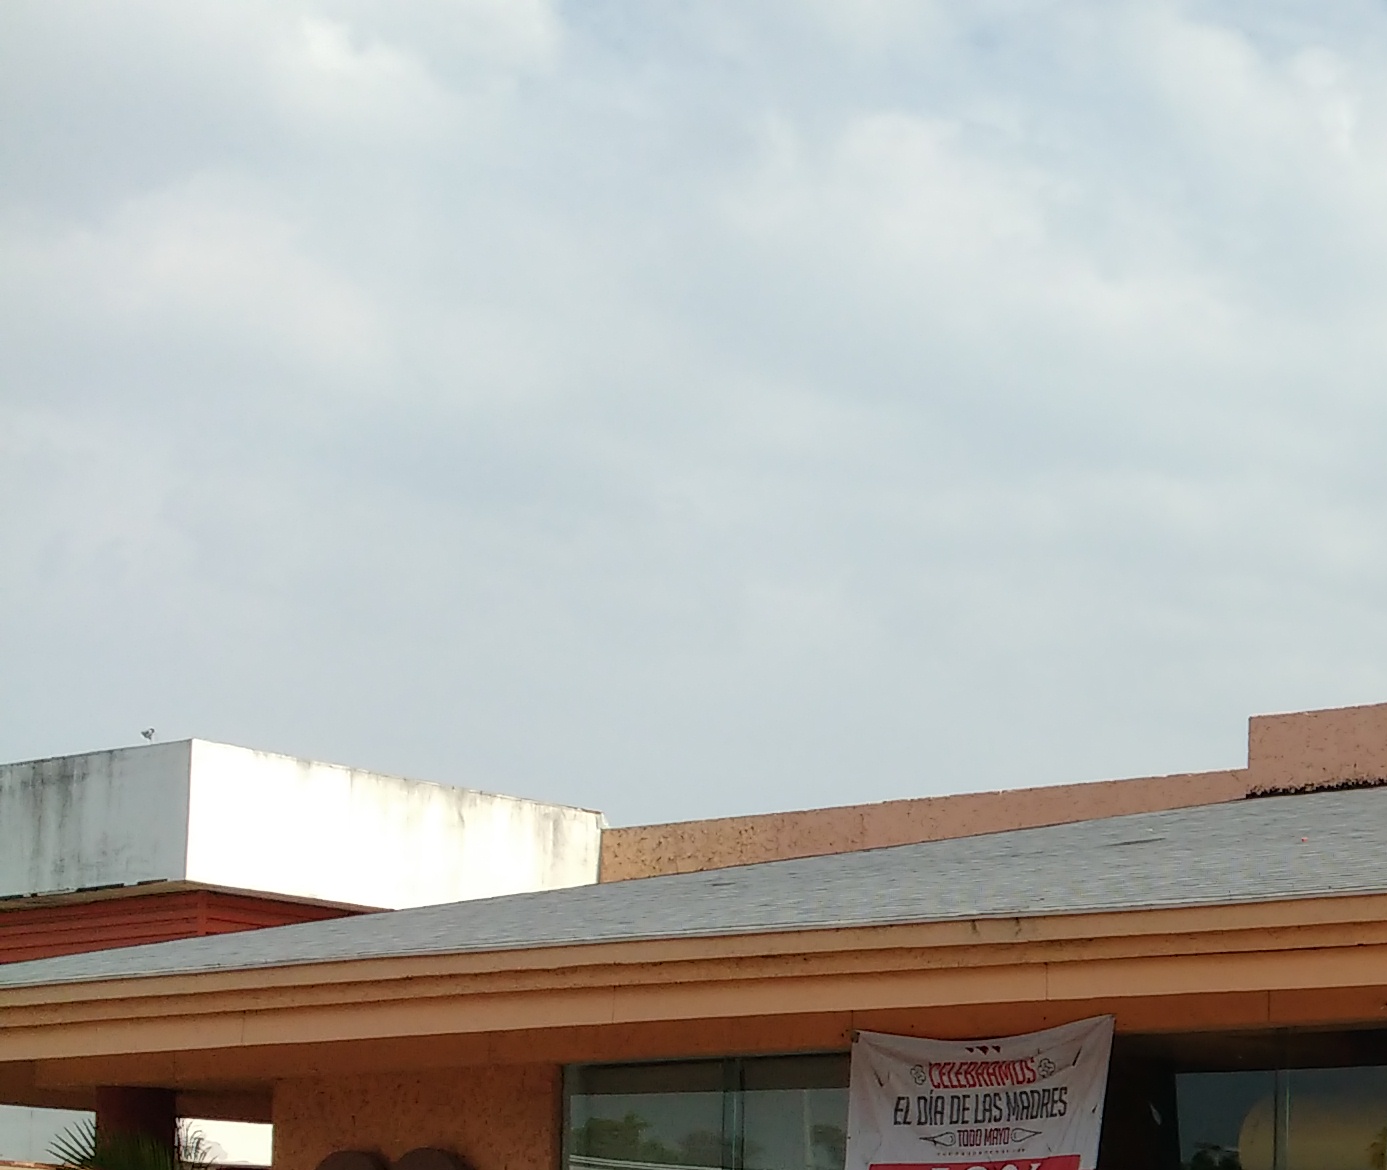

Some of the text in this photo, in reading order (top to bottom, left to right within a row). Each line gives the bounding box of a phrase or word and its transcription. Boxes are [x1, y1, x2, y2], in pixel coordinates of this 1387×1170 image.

[928, 1056, 1037, 1089] CELEBRAMOS
[893, 1086, 1068, 1126] EL DÍA DE LAS MADRES
[956, 1127, 1011, 1148] TODO MAYO
